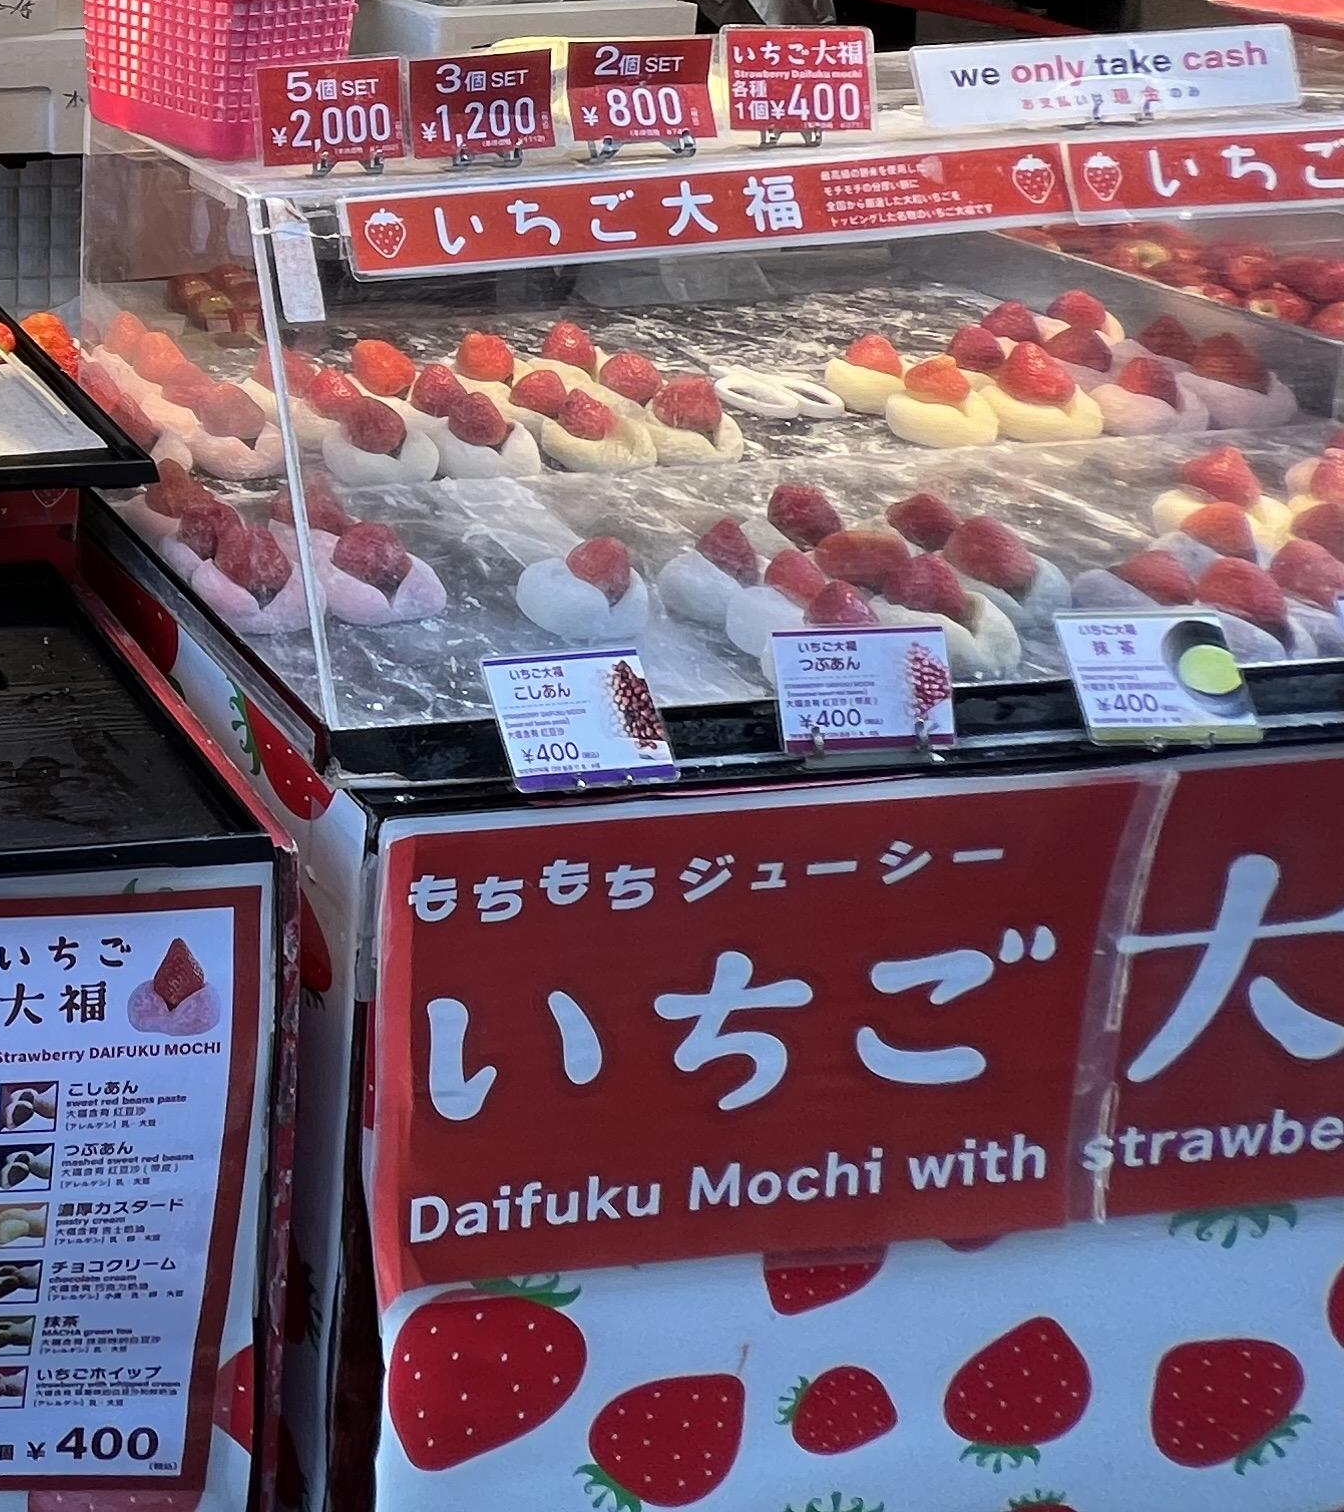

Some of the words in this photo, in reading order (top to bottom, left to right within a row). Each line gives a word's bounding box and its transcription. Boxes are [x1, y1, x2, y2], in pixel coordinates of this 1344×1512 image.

[644, 55, 684, 73] SET
[733, 39, 864, 66] いちご大福
[950, 66, 1001, 88] we
[1011, 55, 1086, 87] only
[1094, 49, 1172, 77] take
[1183, 41, 1268, 72] cash
[341, 79, 379, 97] SET
[490, 69, 529, 88] SET
[732, 80, 768, 98] 各種
[581, 87, 681, 127] ¥800
[770, 82, 861, 121] ¥400
[271, 103, 391, 152] ¥2,000
[421, 96, 536, 146] ¥1,200
[433, 172, 803, 258] いちご大福
[515, 683, 570, 700] こしあん
[408, 840, 1005, 924] もちもちジューシー
[0, 981, 107, 1026] 大福
[89, 1044, 160, 1061] DAIFUKU
[164, 1040, 221, 1057] MOCHI
[68, 1081, 138, 1096] こしあん
[64, 1142, 133, 1157] つぶあん
[410, 1176, 661, 1243] Daifuku
[690, 1146, 883, 1211] Mochi
[909, 1134, 1047, 1188] with
[51, 1257, 176, 1274] チョコクリーム
